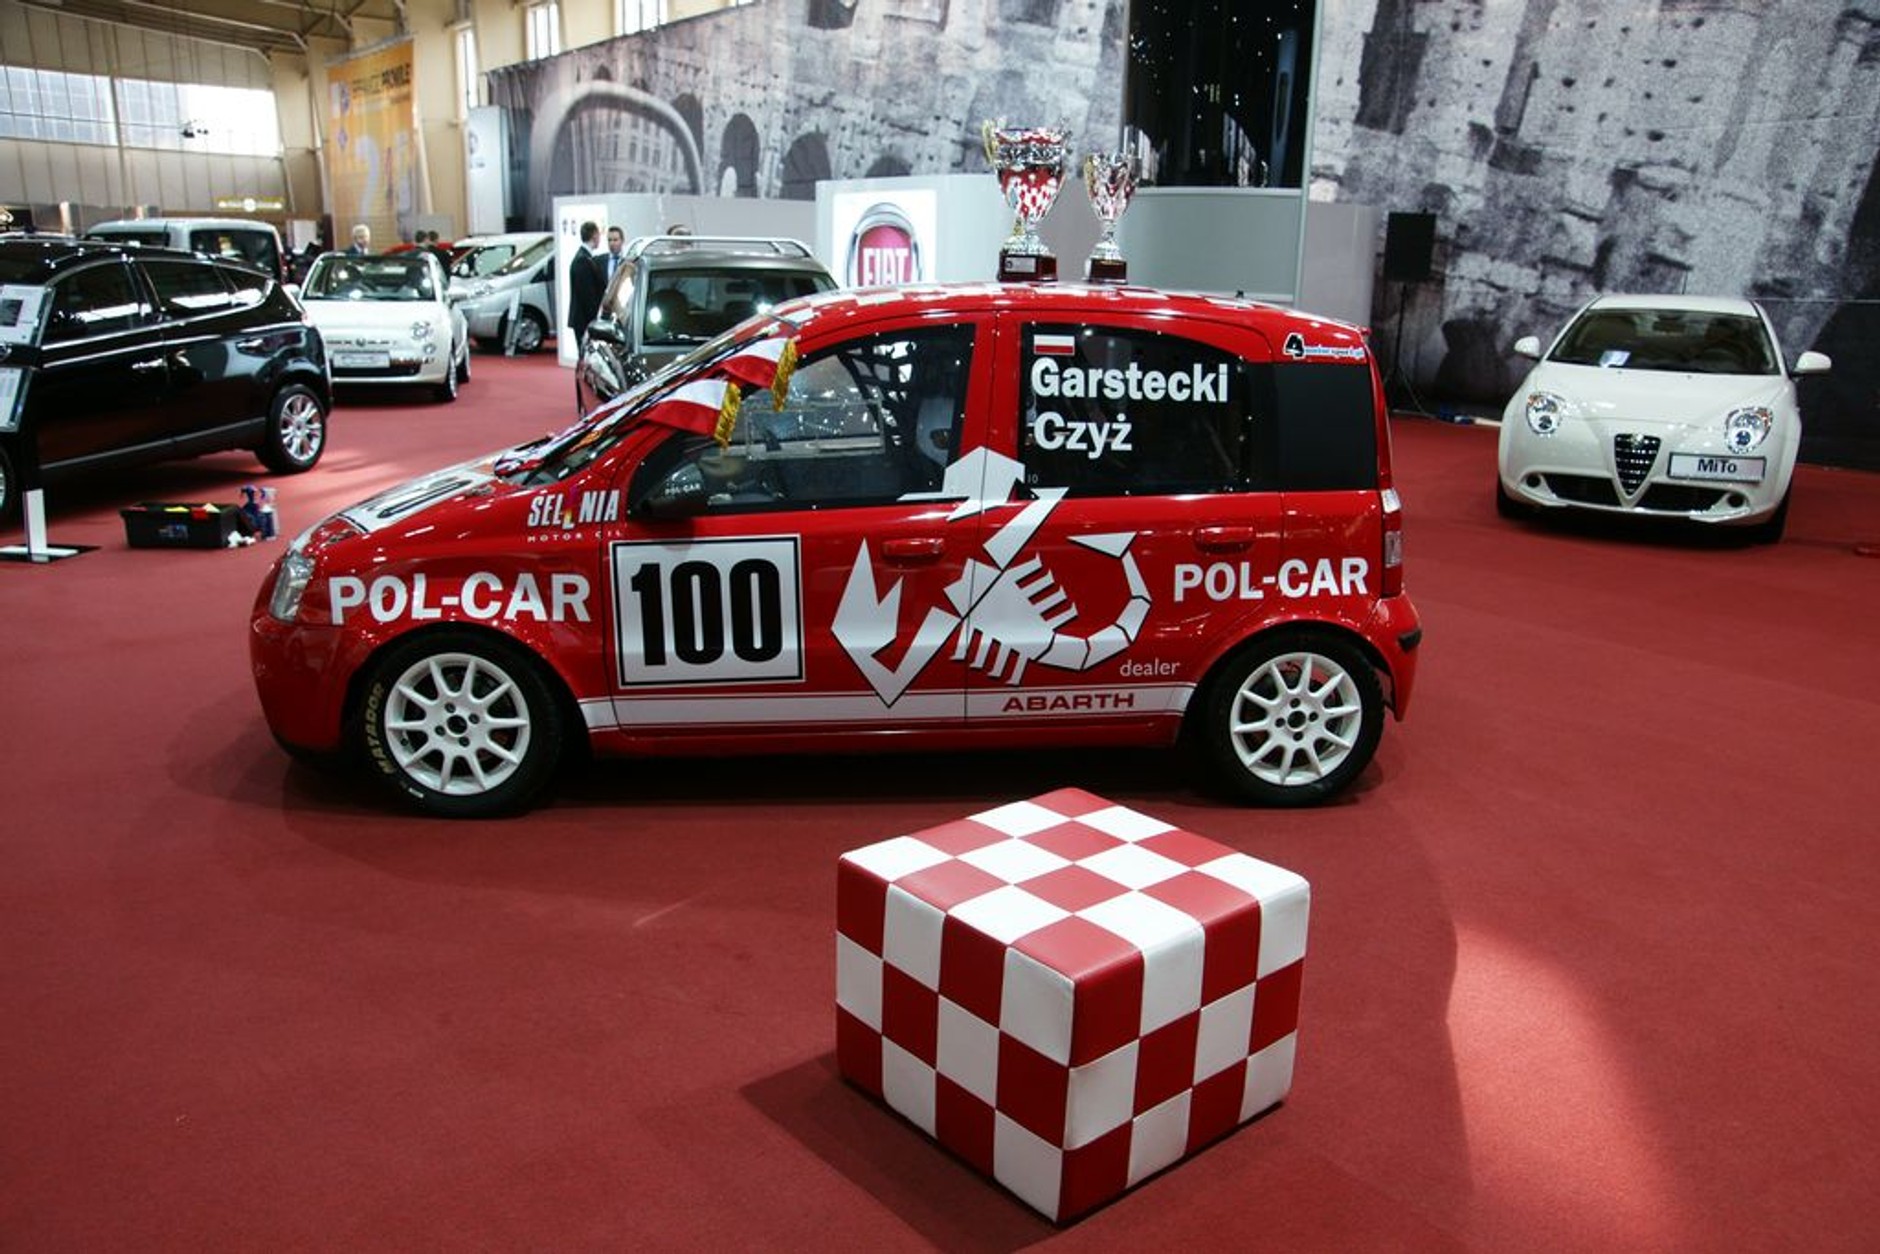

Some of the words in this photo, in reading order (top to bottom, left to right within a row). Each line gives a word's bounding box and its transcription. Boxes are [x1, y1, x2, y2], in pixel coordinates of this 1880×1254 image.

[863, 247, 909, 285] FIAT
[1031, 357, 1228, 402] Garstecki
[1033, 411, 1132, 459] Czyż
[1697, 458, 1737, 473] MiTo
[527, 532, 583, 543] MOTOR
[595, 530, 623, 540] OIL
[328, 572, 591, 626] POL-CAR
[1174, 557, 1369, 602] POL-CAR
[631, 558, 783, 667] 100
[1119, 657, 1181, 677] dealer
[1002, 693, 1134, 713] ABARTH
[365, 681, 395, 776] MATADOR
